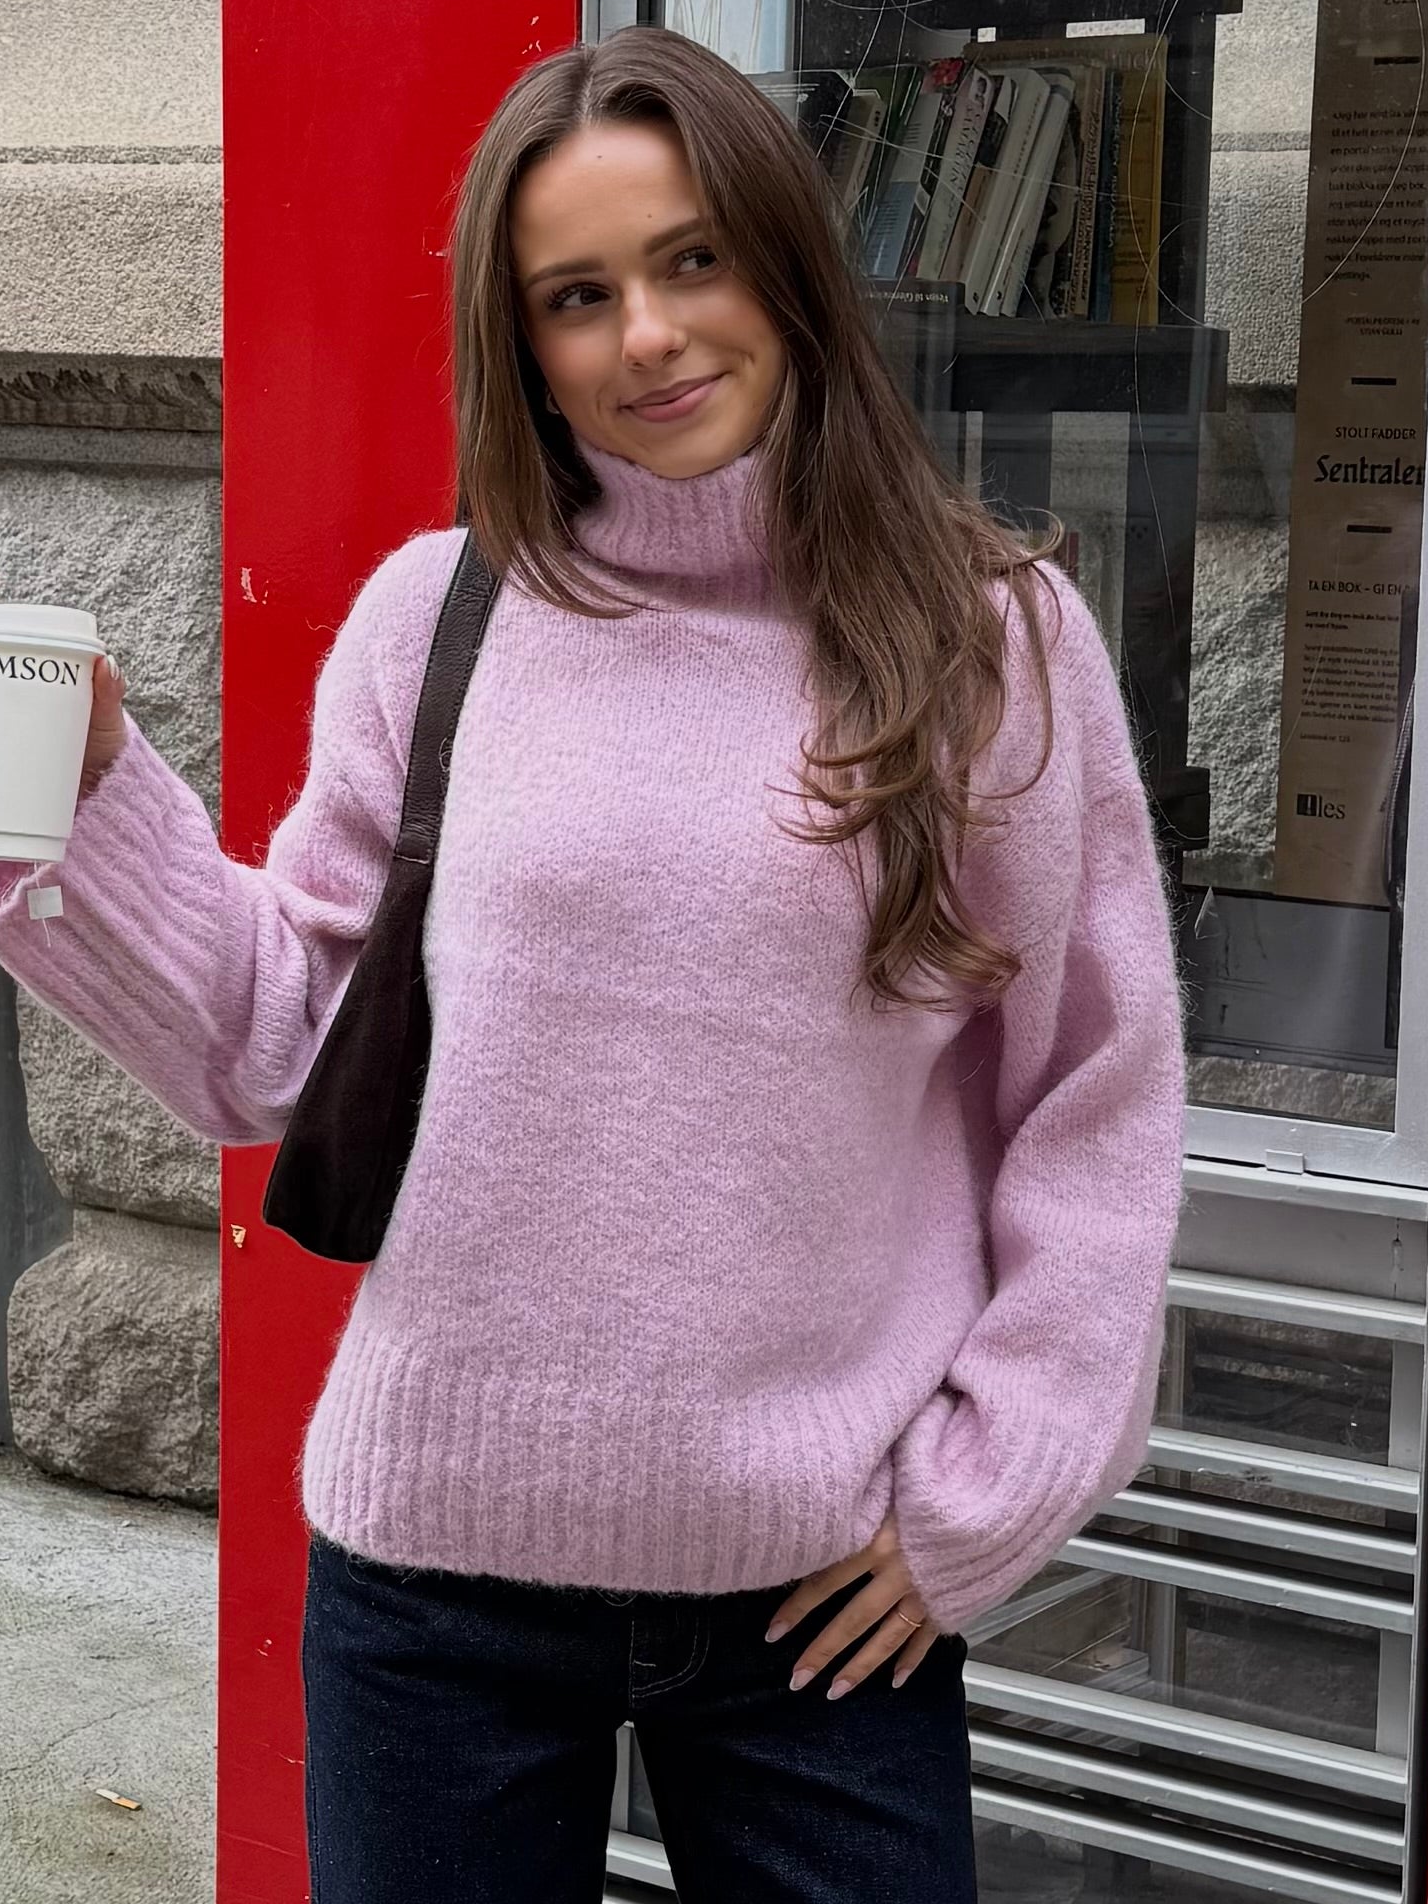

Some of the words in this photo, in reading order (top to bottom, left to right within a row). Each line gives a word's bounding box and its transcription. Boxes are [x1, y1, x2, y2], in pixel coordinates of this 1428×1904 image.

[1334, 426, 1369, 439] STOLT
[1371, 427, 1417, 440] FADDER
[1308, 579, 1320, 592] TA
[1337, 581, 1362, 594] BOK
[1372, 583, 1385, 595] GI
